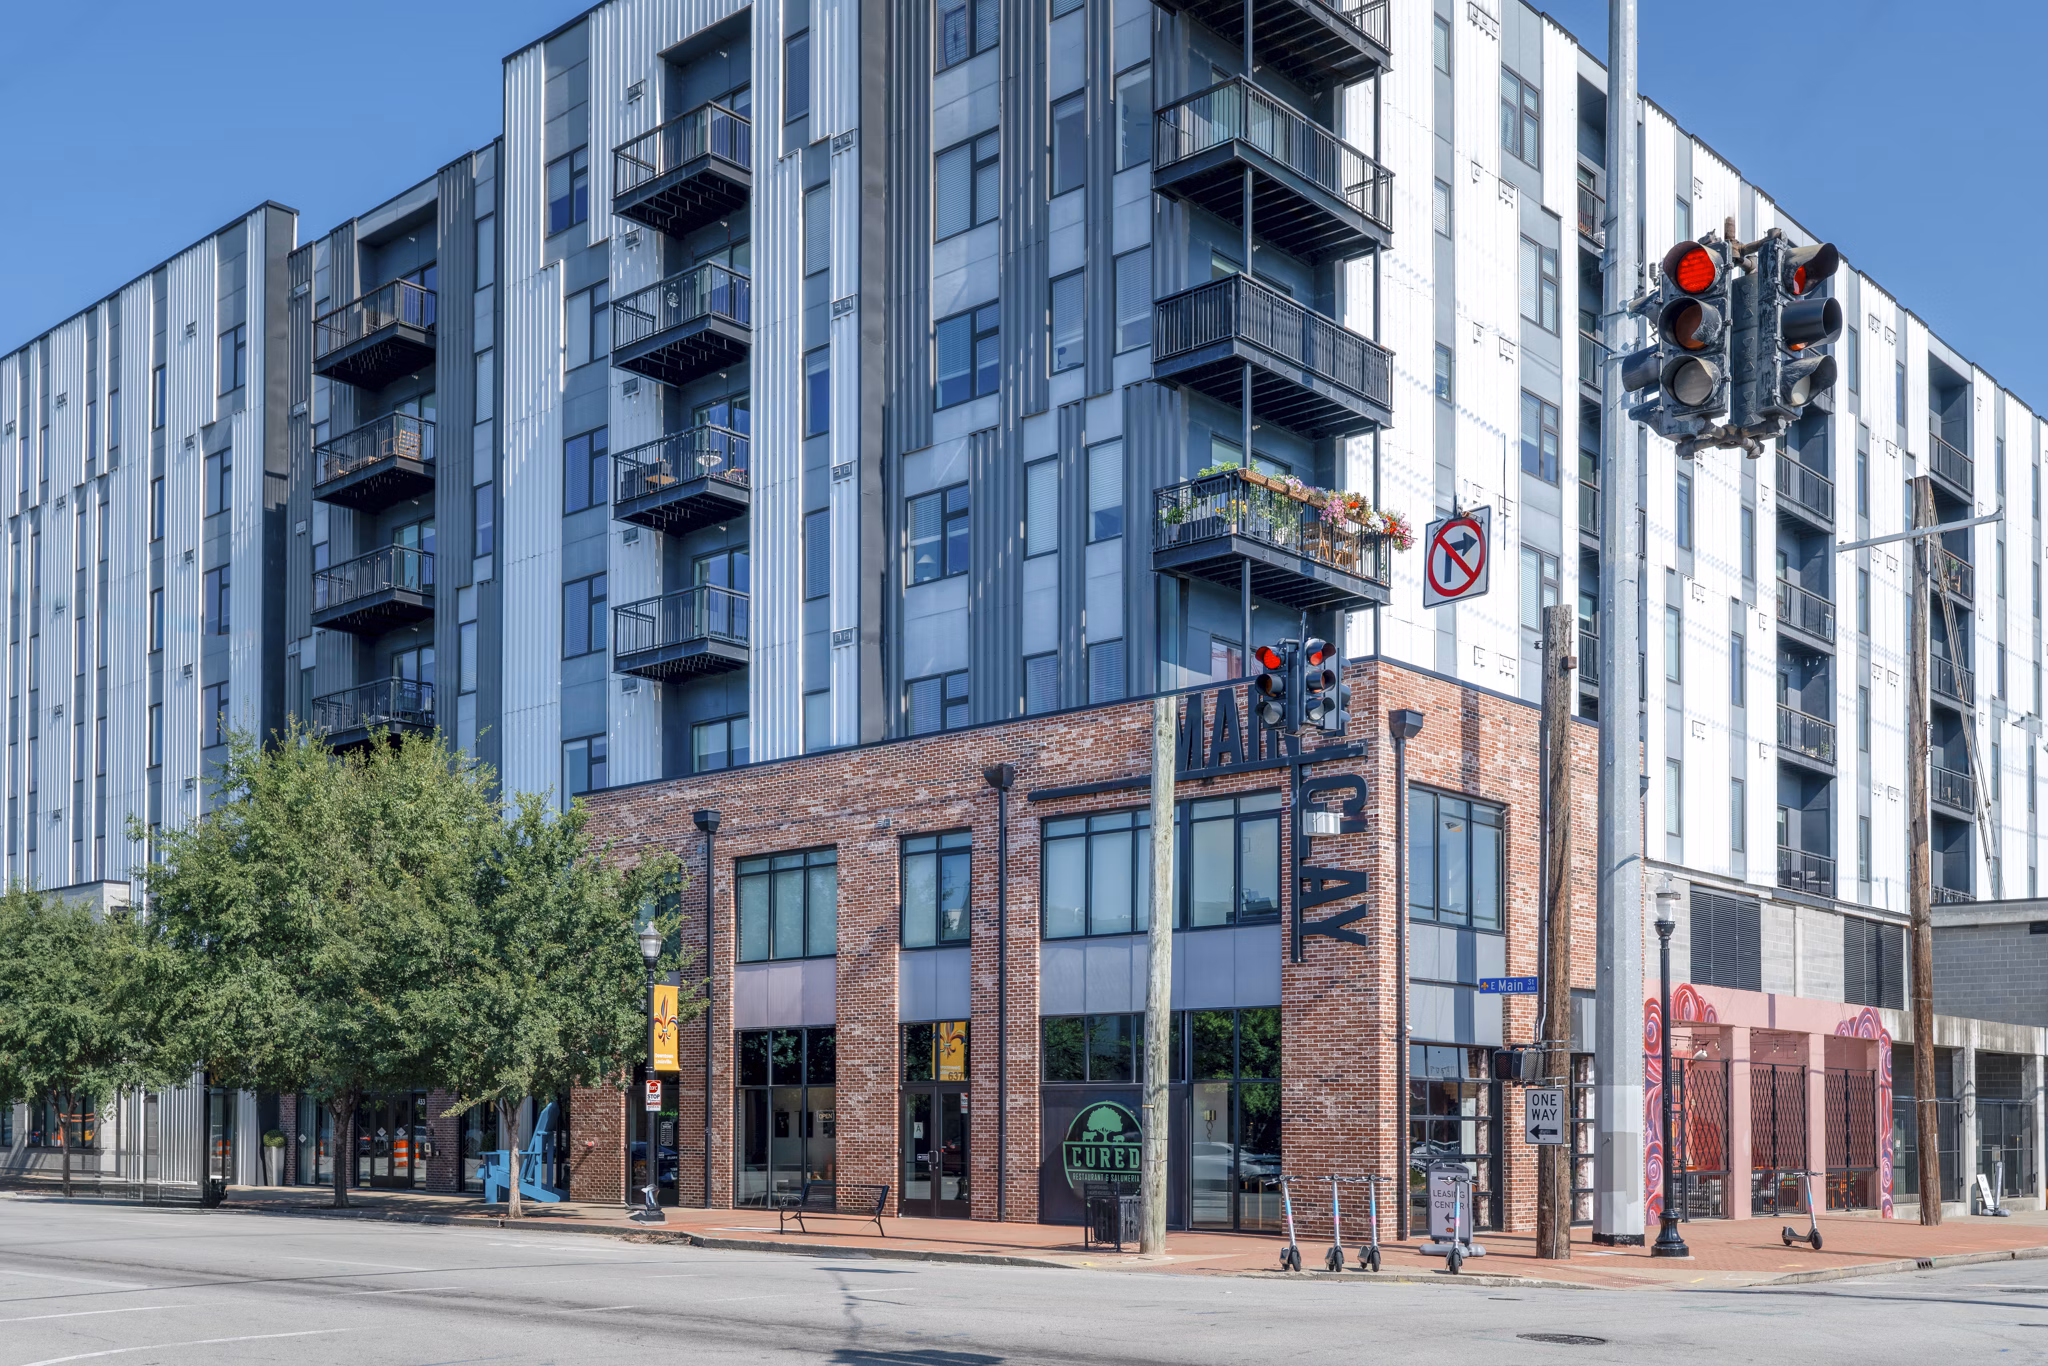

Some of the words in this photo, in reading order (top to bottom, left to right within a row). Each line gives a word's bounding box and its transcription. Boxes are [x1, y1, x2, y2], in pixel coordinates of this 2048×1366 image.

[1490, 981, 1497, 990] E
[1498, 979, 1524, 992] Main
[1527, 978, 1536, 986] St
[948, 1072, 964, 1081] 637
[1532, 1093, 1557, 1106] ONE
[1531, 1108, 1558, 1121] WAY
[1072, 1147, 1140, 1168] CURED
[1072, 1173, 1104, 1181] RESTAURANT
[1111, 1174, 1140, 1182] SALUMERIA
[1432, 1190, 1465, 1198] LEASIG
[1434, 1201, 1465, 1210] CENTR
